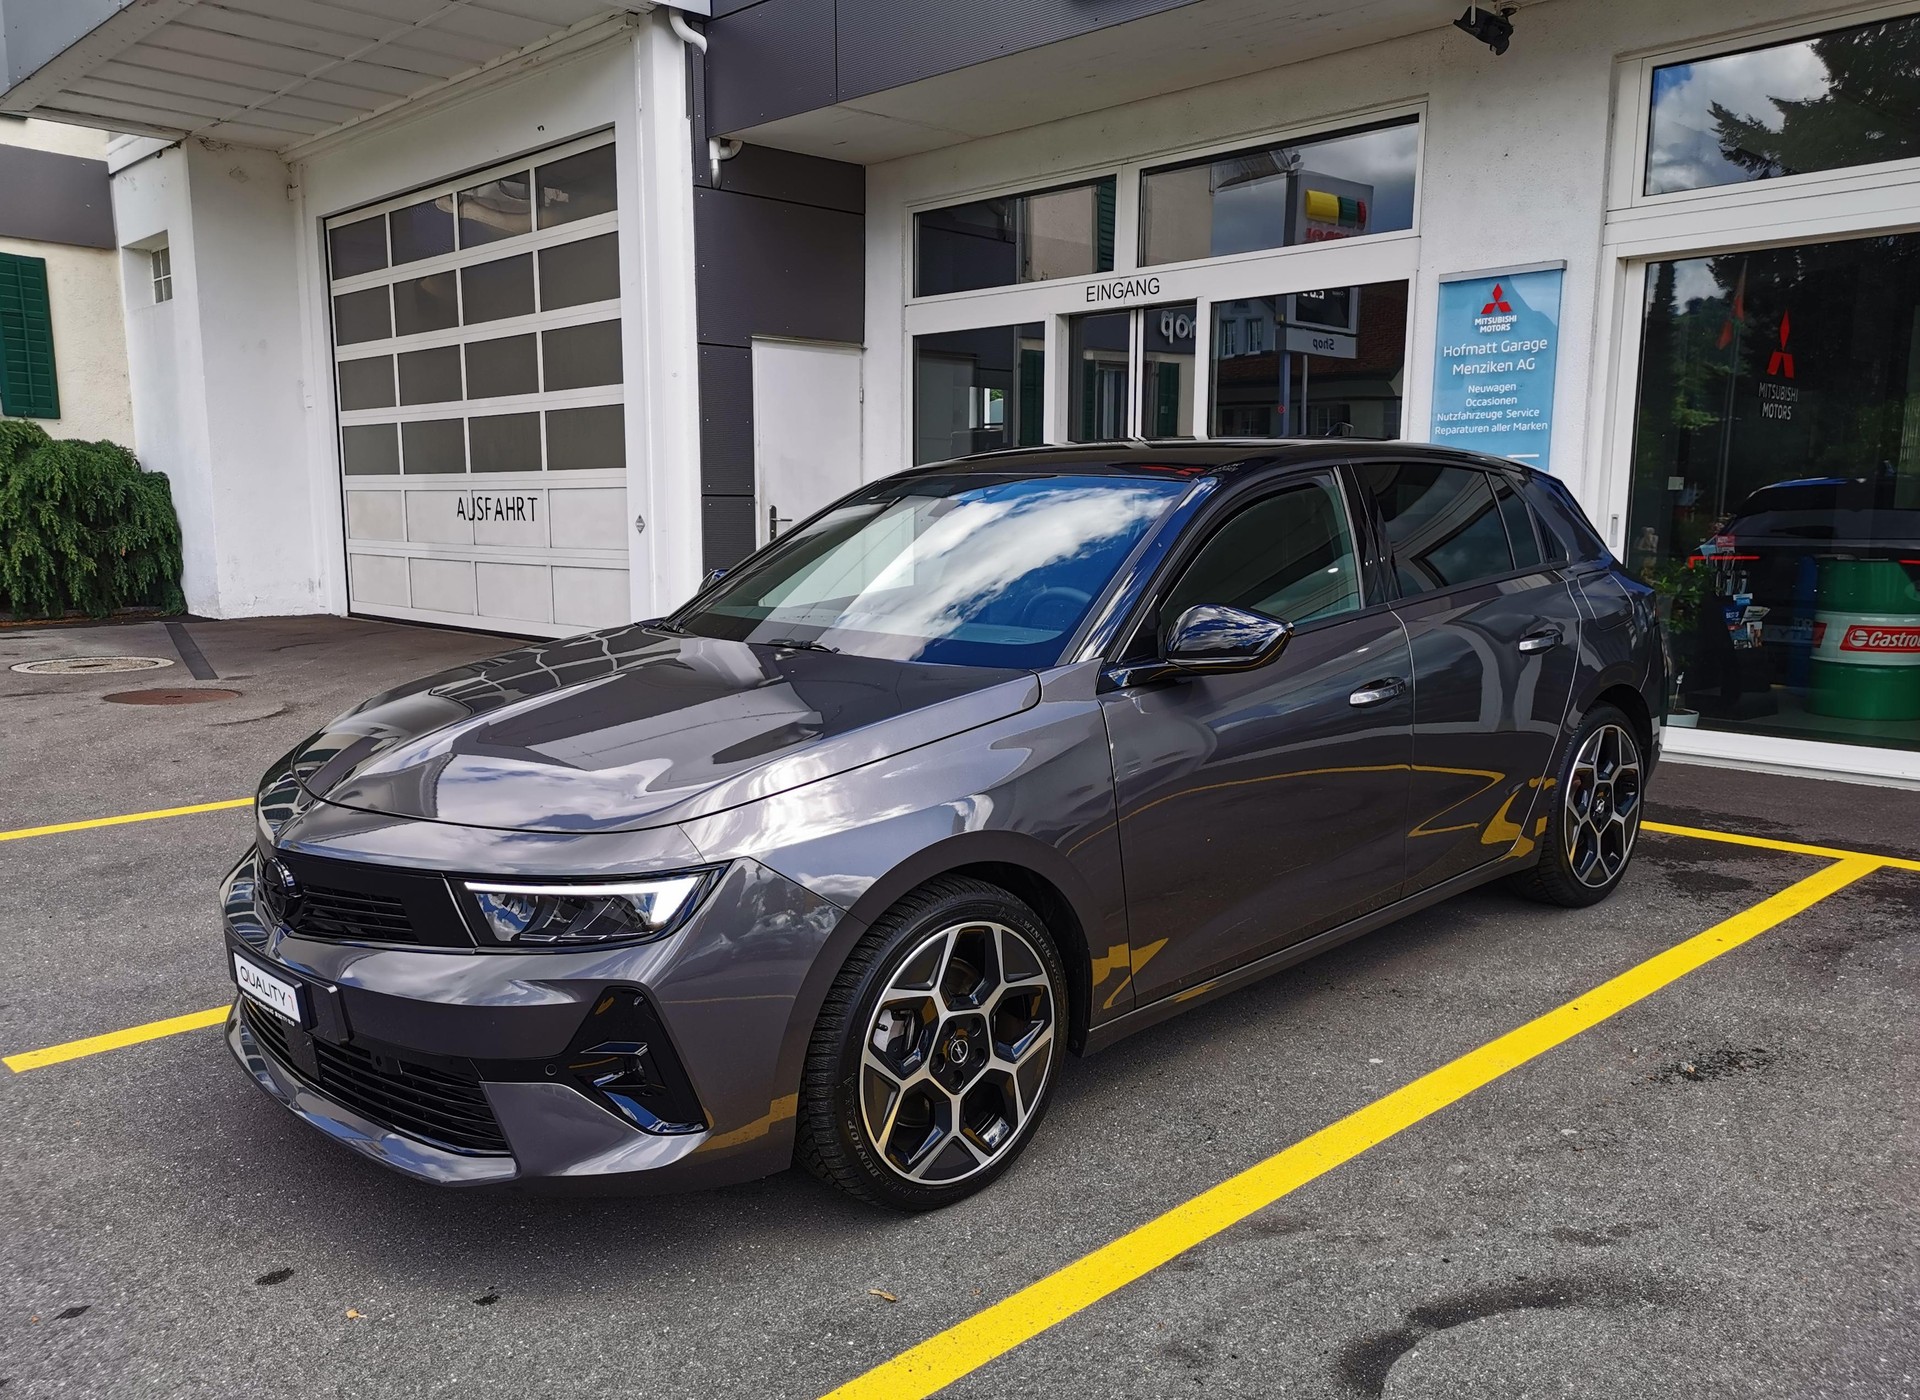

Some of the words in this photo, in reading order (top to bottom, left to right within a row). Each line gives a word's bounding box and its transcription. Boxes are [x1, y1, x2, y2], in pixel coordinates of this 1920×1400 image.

[1086, 277, 1160, 303] EINGANG
[1474, 315, 1517, 325] MITSUBISHI
[1480, 324, 1510, 333] MOTORS
[1443, 341, 1497, 357] Hofmatt
[1501, 338, 1548, 355] Garage
[1452, 360, 1513, 375] Menziken
[1517, 358, 1536, 371] AG
[1468, 383, 1516, 394] Neuwagen
[1758, 382, 1799, 402] MITSUBISHI
[1465, 397, 1517, 407] Occasionen
[1437, 410, 1503, 421] Nutzfahrzeuge
[1506, 409, 1540, 419] Service
[1761, 402, 1792, 420] MOTORS
[1434, 423, 1489, 436] Reparaturen
[1491, 422, 1511, 432] aller
[1513, 421, 1548, 432] Marken
[457, 496, 538, 522] AUSFAHRT
[847, 1120, 881, 1178] DUNLOP
